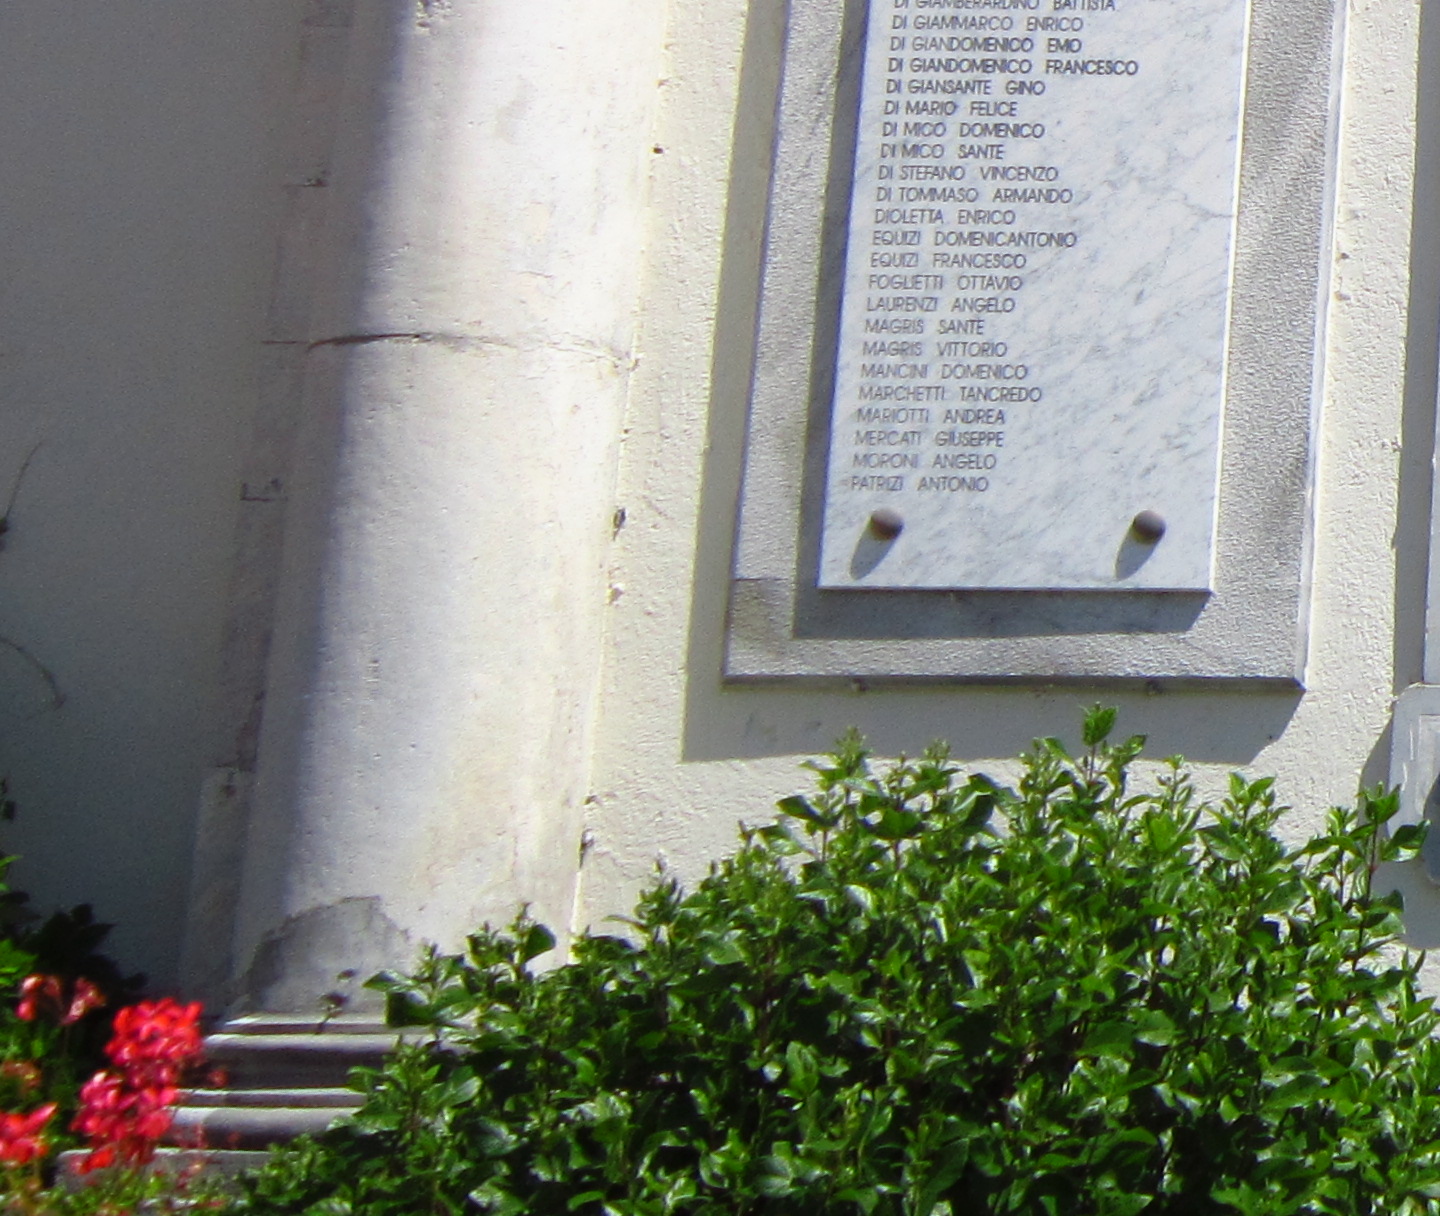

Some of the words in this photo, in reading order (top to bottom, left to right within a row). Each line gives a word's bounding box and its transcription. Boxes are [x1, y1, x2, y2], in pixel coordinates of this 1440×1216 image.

[889, 58, 903, 72] DI
[910, 58, 1032, 73] GIANDOMENICO
[1045, 59, 1138, 75] FRANCESCO
[884, 101, 898, 115] DI
[906, 101, 956, 116] MARIO
[970, 102, 1017, 117] FELICE
[877, 188, 892, 202] DI
[899, 188, 978, 203] TOMMASO
[993, 189, 1072, 204] ARMANDO
[875, 210, 944, 224] DIOLETTA
[958, 210, 1015, 225] ENRICO
[869, 275, 943, 290] FOGLIETTI
[957, 276, 1023, 291] OTTAVIO
[859, 386, 945, 401] MARCHETTI
[959, 387, 1041, 402] TANCREDO
